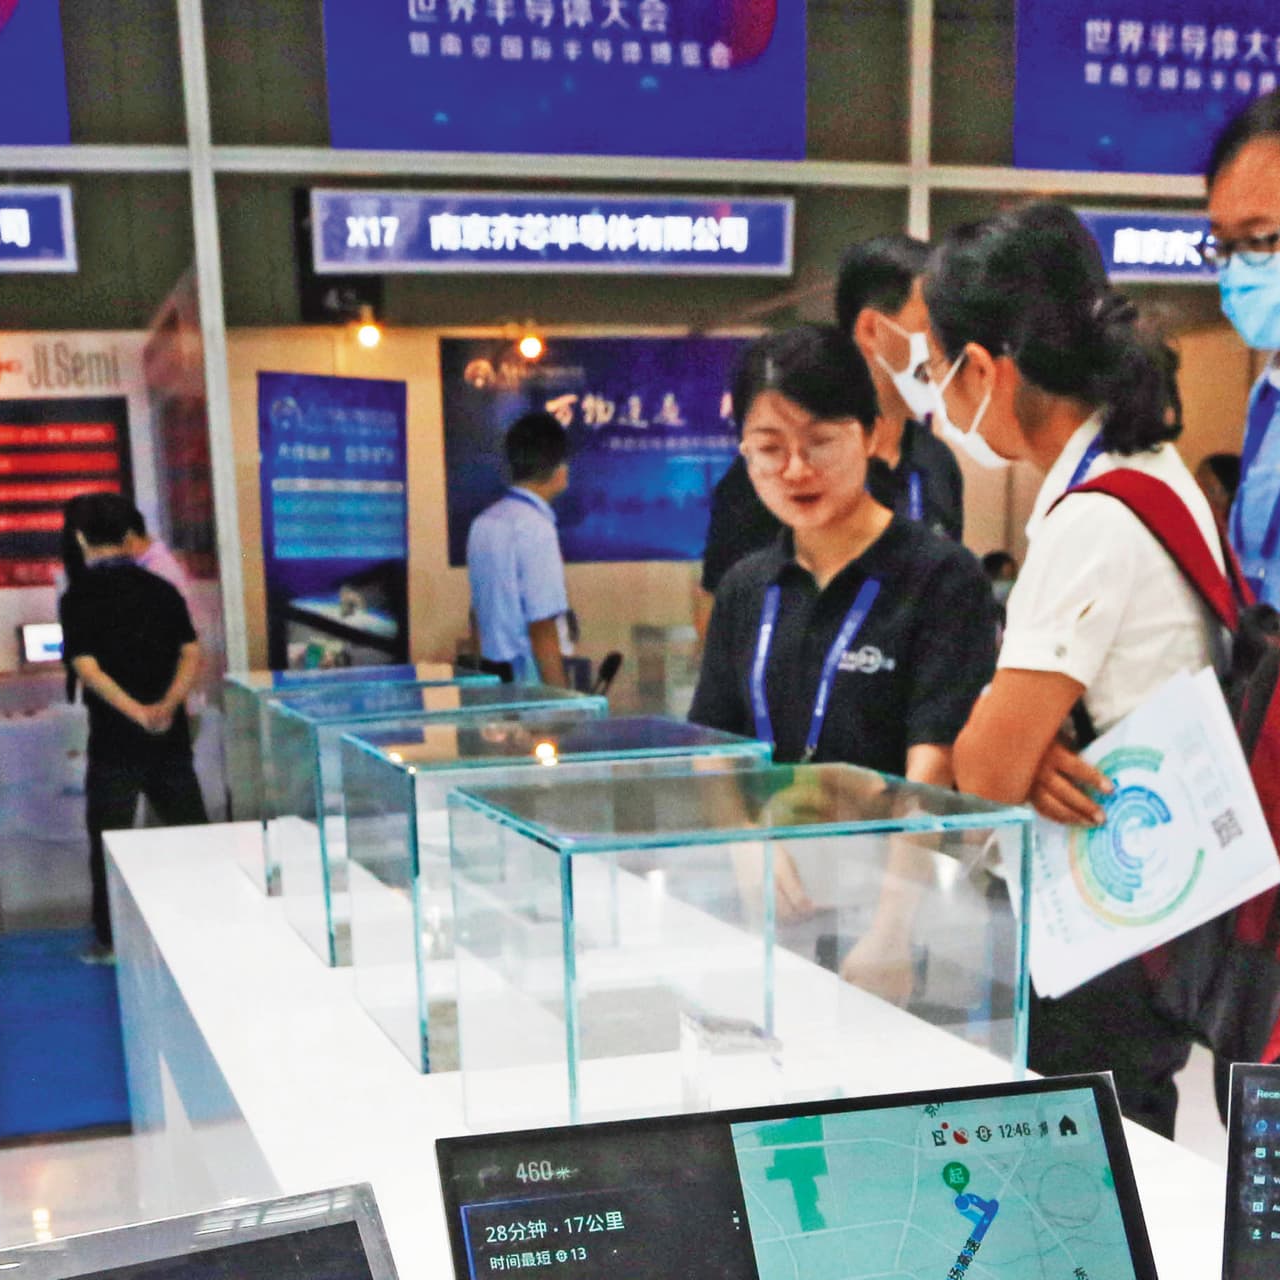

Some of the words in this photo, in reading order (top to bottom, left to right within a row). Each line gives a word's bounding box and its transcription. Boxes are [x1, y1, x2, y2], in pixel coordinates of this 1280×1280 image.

[345, 215, 400, 249] X17
[999, 1121, 1032, 1140] 12:46
[489, 1250, 553, 1272] 时间最短
[570, 1247, 588, 1261] 13
